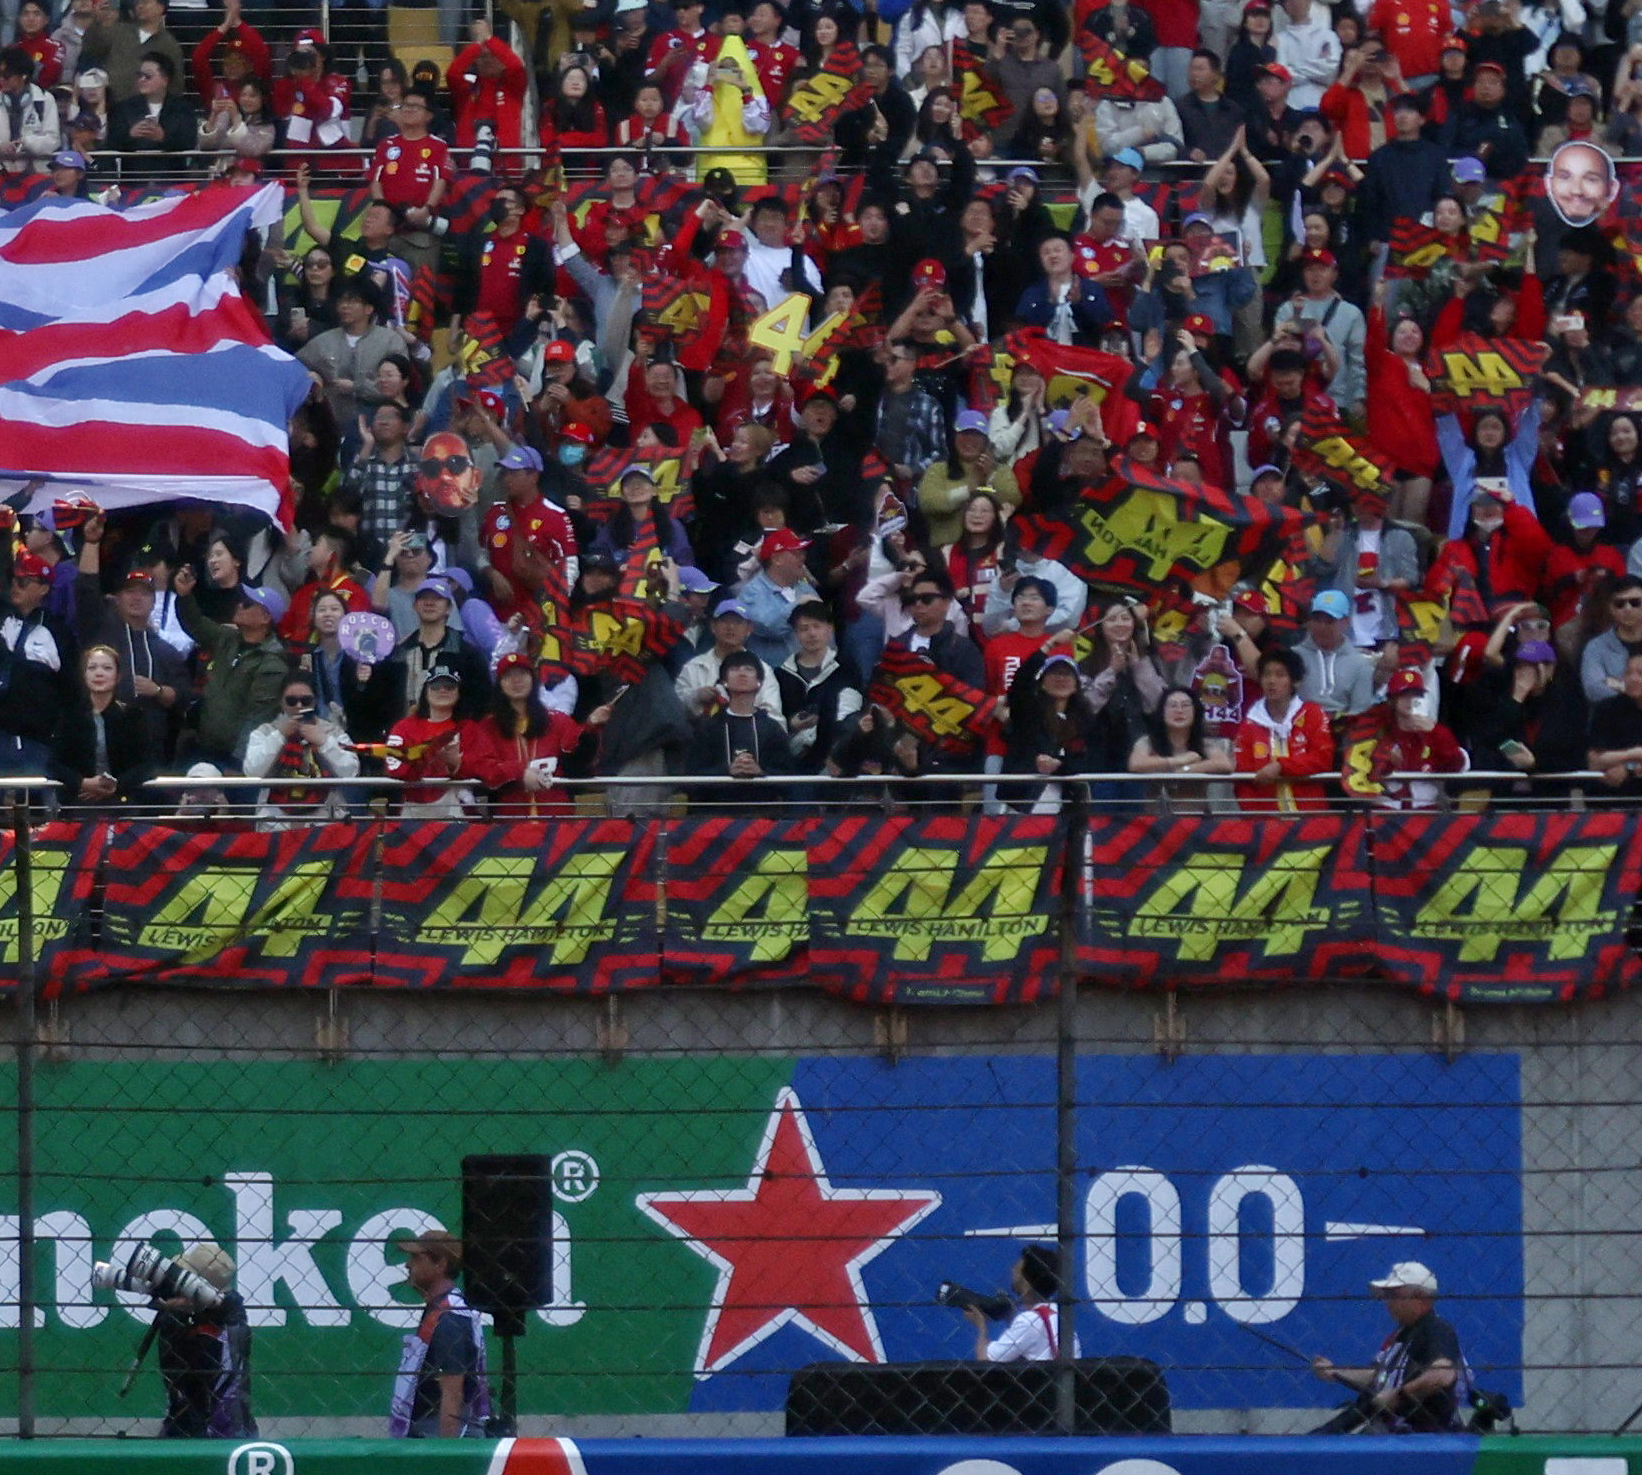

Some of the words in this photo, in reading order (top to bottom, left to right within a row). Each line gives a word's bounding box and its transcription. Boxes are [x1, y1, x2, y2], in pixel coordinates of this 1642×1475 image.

[1442, 352, 1525, 398] 44
[895, 674, 976, 736] 44
[138, 860, 335, 965] 44
[414, 851, 627, 966] 44
[425, 927, 496, 943] LEWIS
[502, 925, 608, 943] HAMILTON
[715, 923, 782, 940] LEWIS
[845, 847, 1050, 962] 44
[856, 919, 923, 937] LEWIS
[928, 918, 1040, 937] HAMILTON
[1127, 846, 1332, 960] 44
[1138, 918, 1210, 936] LEWIS
[1411, 845, 1619, 963] 44
[147, 930, 216, 948] LEWIS
[1085, 1164, 1306, 1326] 0.0
